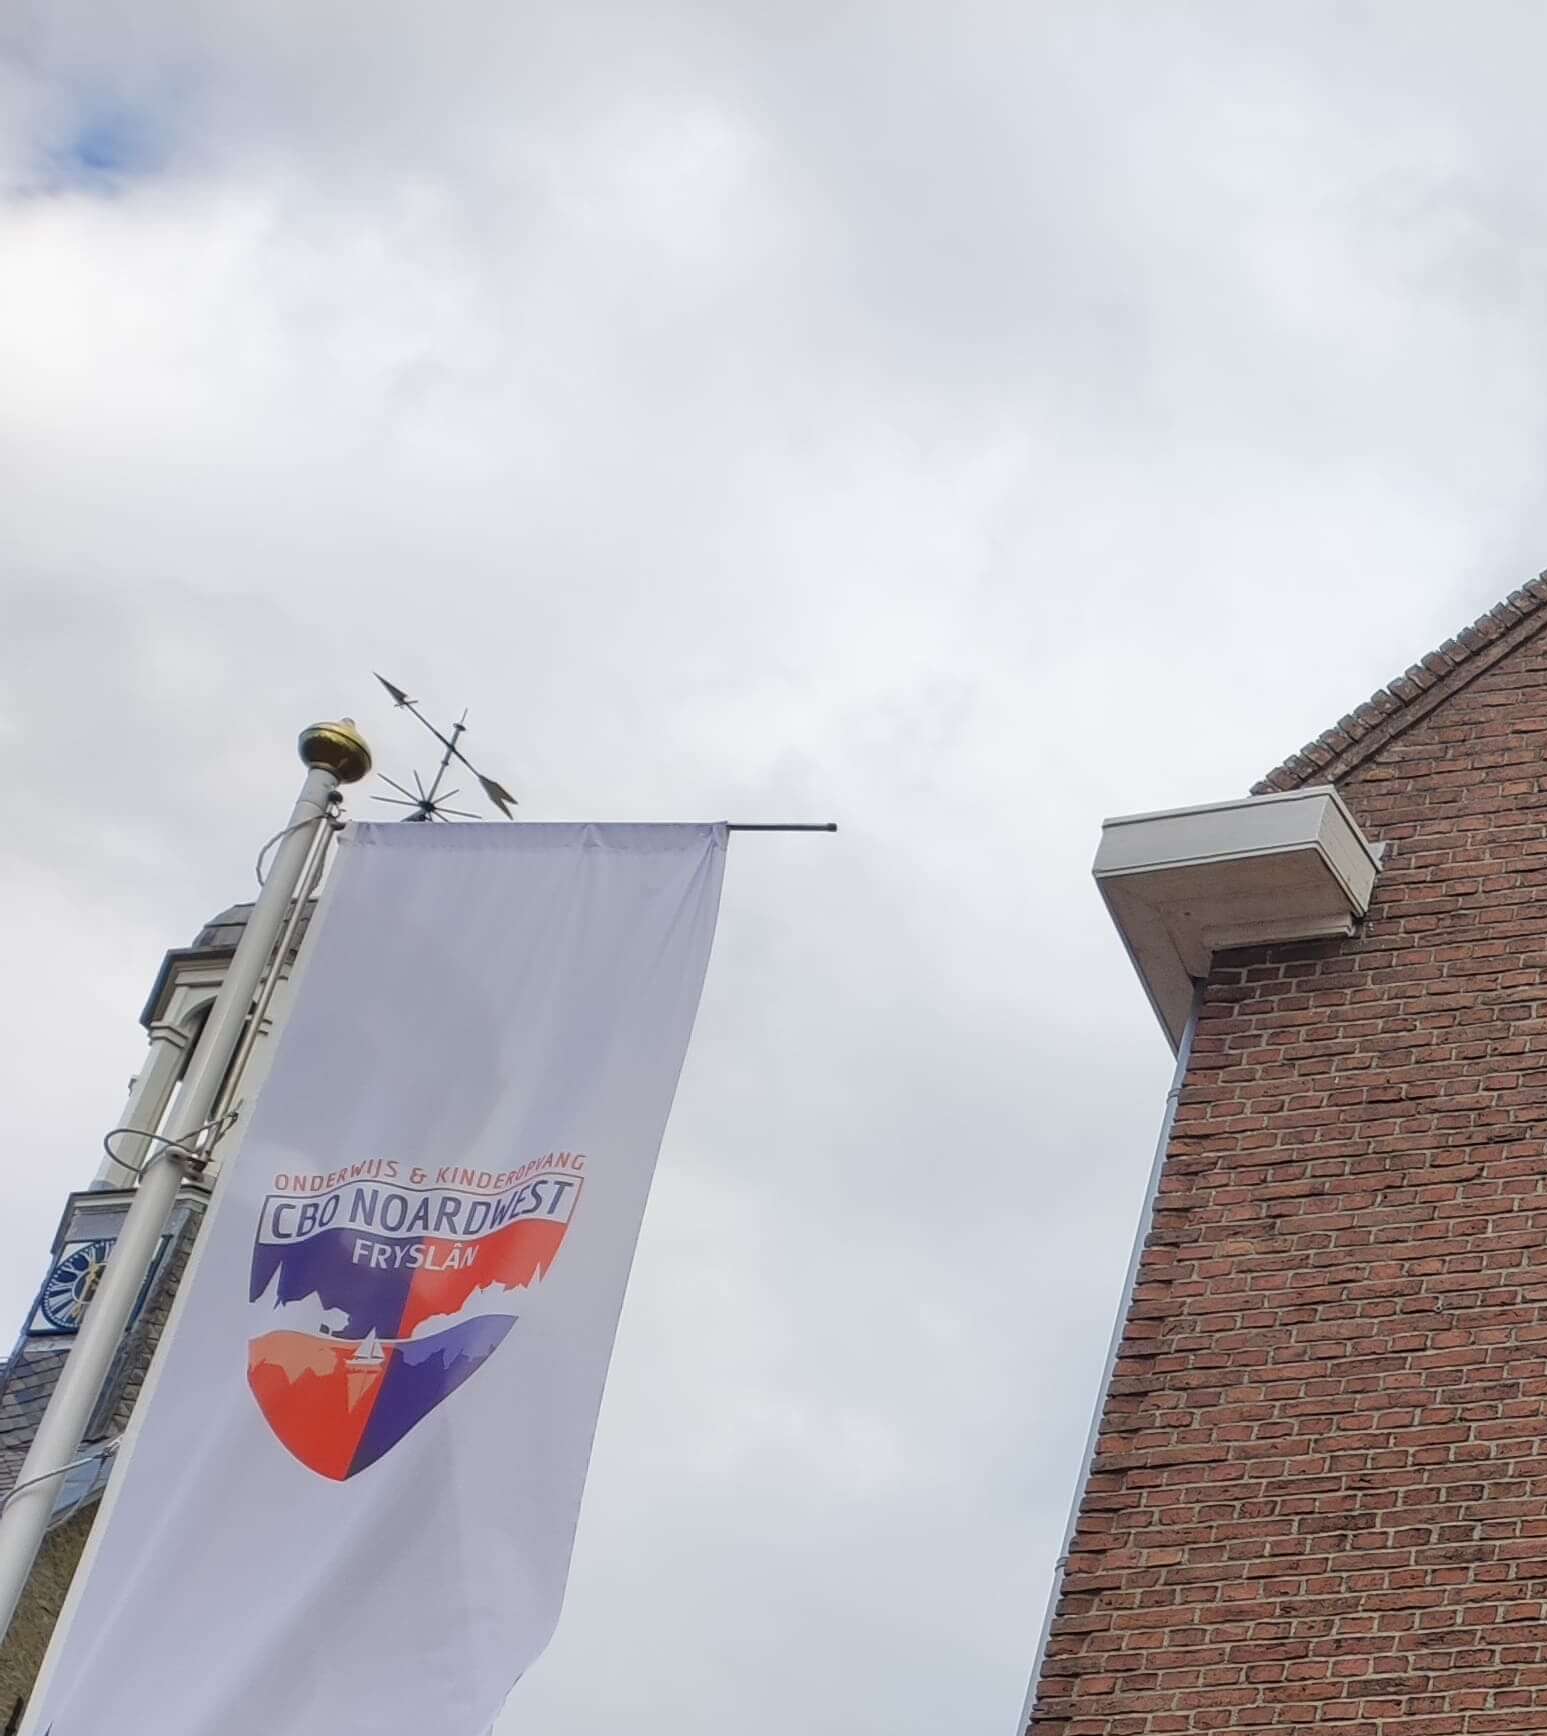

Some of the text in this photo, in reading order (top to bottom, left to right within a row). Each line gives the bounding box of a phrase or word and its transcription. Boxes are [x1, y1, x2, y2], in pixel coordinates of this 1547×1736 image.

[275, 1151, 587, 1192] ONDERWIJS & KINDEROPVANG
[271, 1179, 575, 1239] CBO NOARDWEST
[351, 1239, 479, 1270] FRYSLÂN
